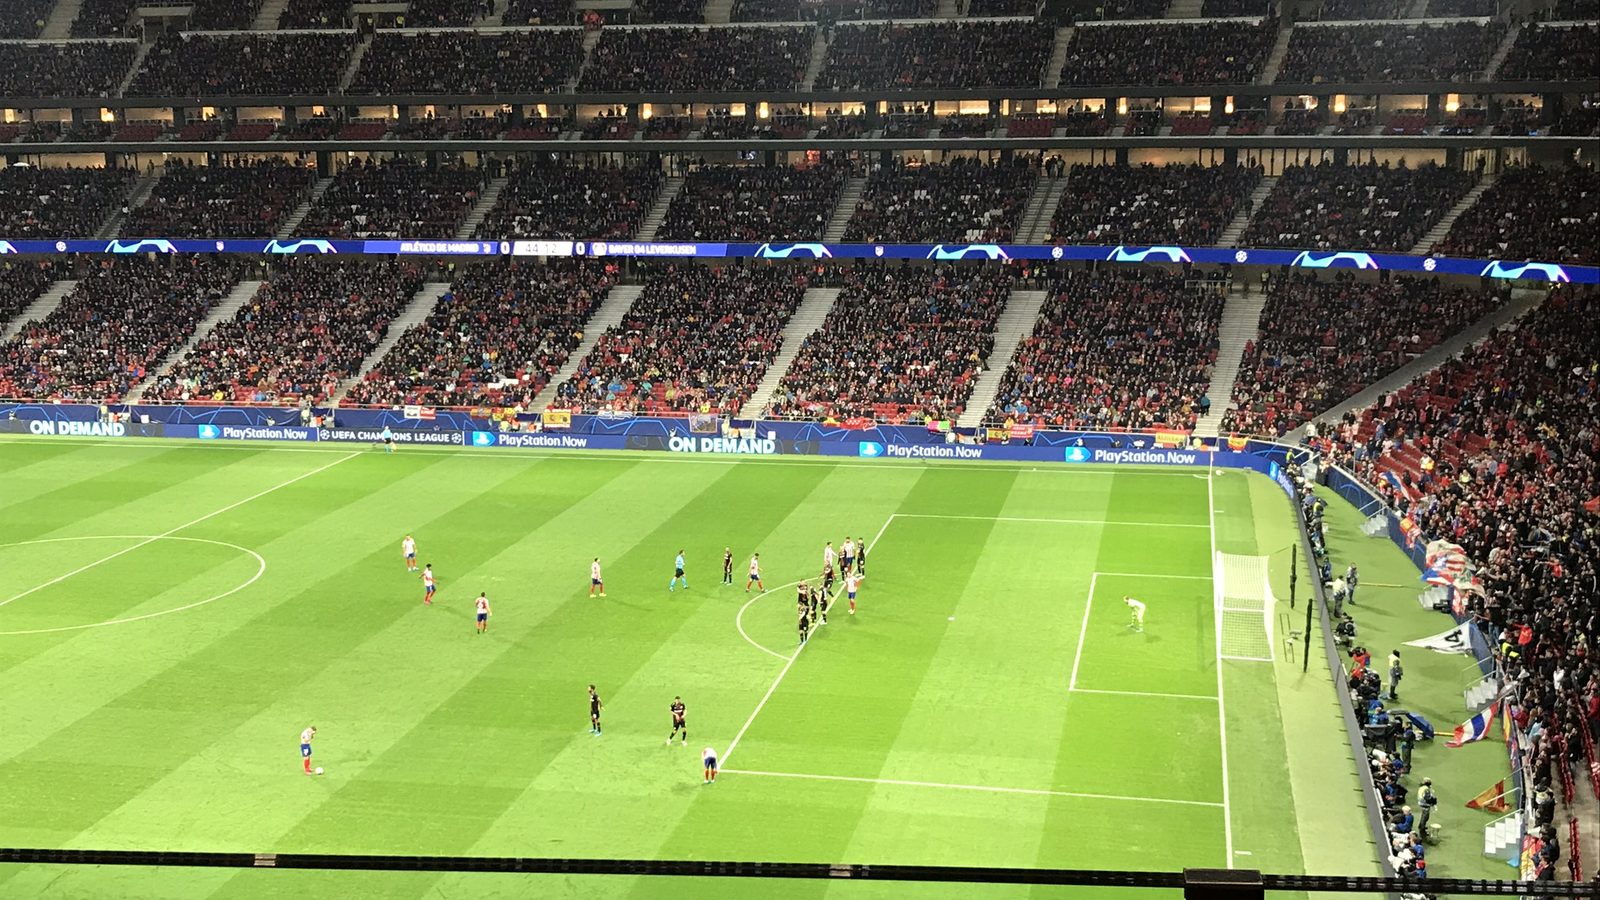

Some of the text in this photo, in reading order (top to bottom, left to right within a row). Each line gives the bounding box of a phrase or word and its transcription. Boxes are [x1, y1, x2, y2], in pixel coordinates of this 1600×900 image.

[501, 241, 510, 255] 0
[576, 242, 585, 255] 0
[30, 420, 125, 437] ON DEMAND
[223, 427, 308, 440] PlayStation Now
[331, 431, 450, 443] UEFA CHAMIONS LEAGUE
[499, 434, 587, 448] PlayStation Now
[668, 437, 775, 454] ON DEMAND
[887, 444, 982, 458] PlayStation Now
[1095, 450, 1195, 464] PlayStation Now
